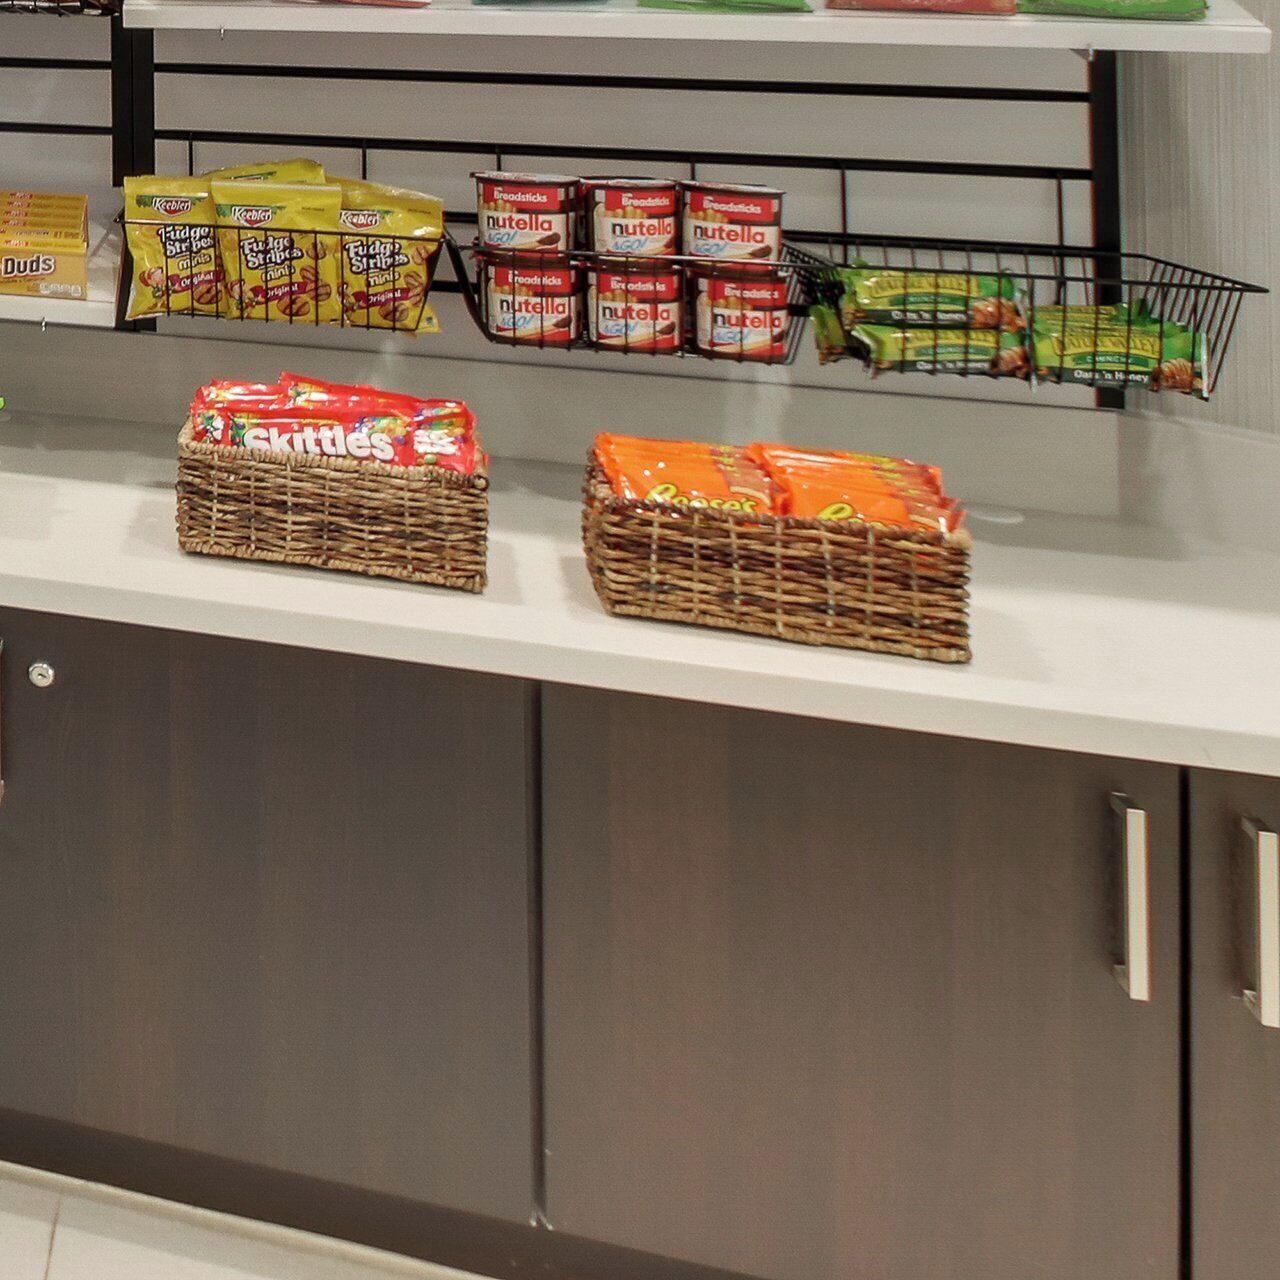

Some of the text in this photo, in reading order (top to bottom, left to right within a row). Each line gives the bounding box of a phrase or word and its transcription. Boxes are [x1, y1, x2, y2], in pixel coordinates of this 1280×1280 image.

[154, 198, 191, 212] Keebler
[493, 190, 548, 203] Breadsticks
[232, 206, 272, 222] Keebler
[703, 200, 762, 214] Breadsticks
[340, 210, 379, 225] Keebler
[486, 211, 553, 232] nutella
[611, 219, 672, 237] nutella
[693, 224, 766, 245] nutella
[1, 254, 56, 279] Duds
[178, 254, 211, 270] minis
[499, 294, 567, 316] nutella
[602, 302, 671, 321] nutella
[713, 310, 781, 330] nutella
[242, 425, 398, 461] Skittles
